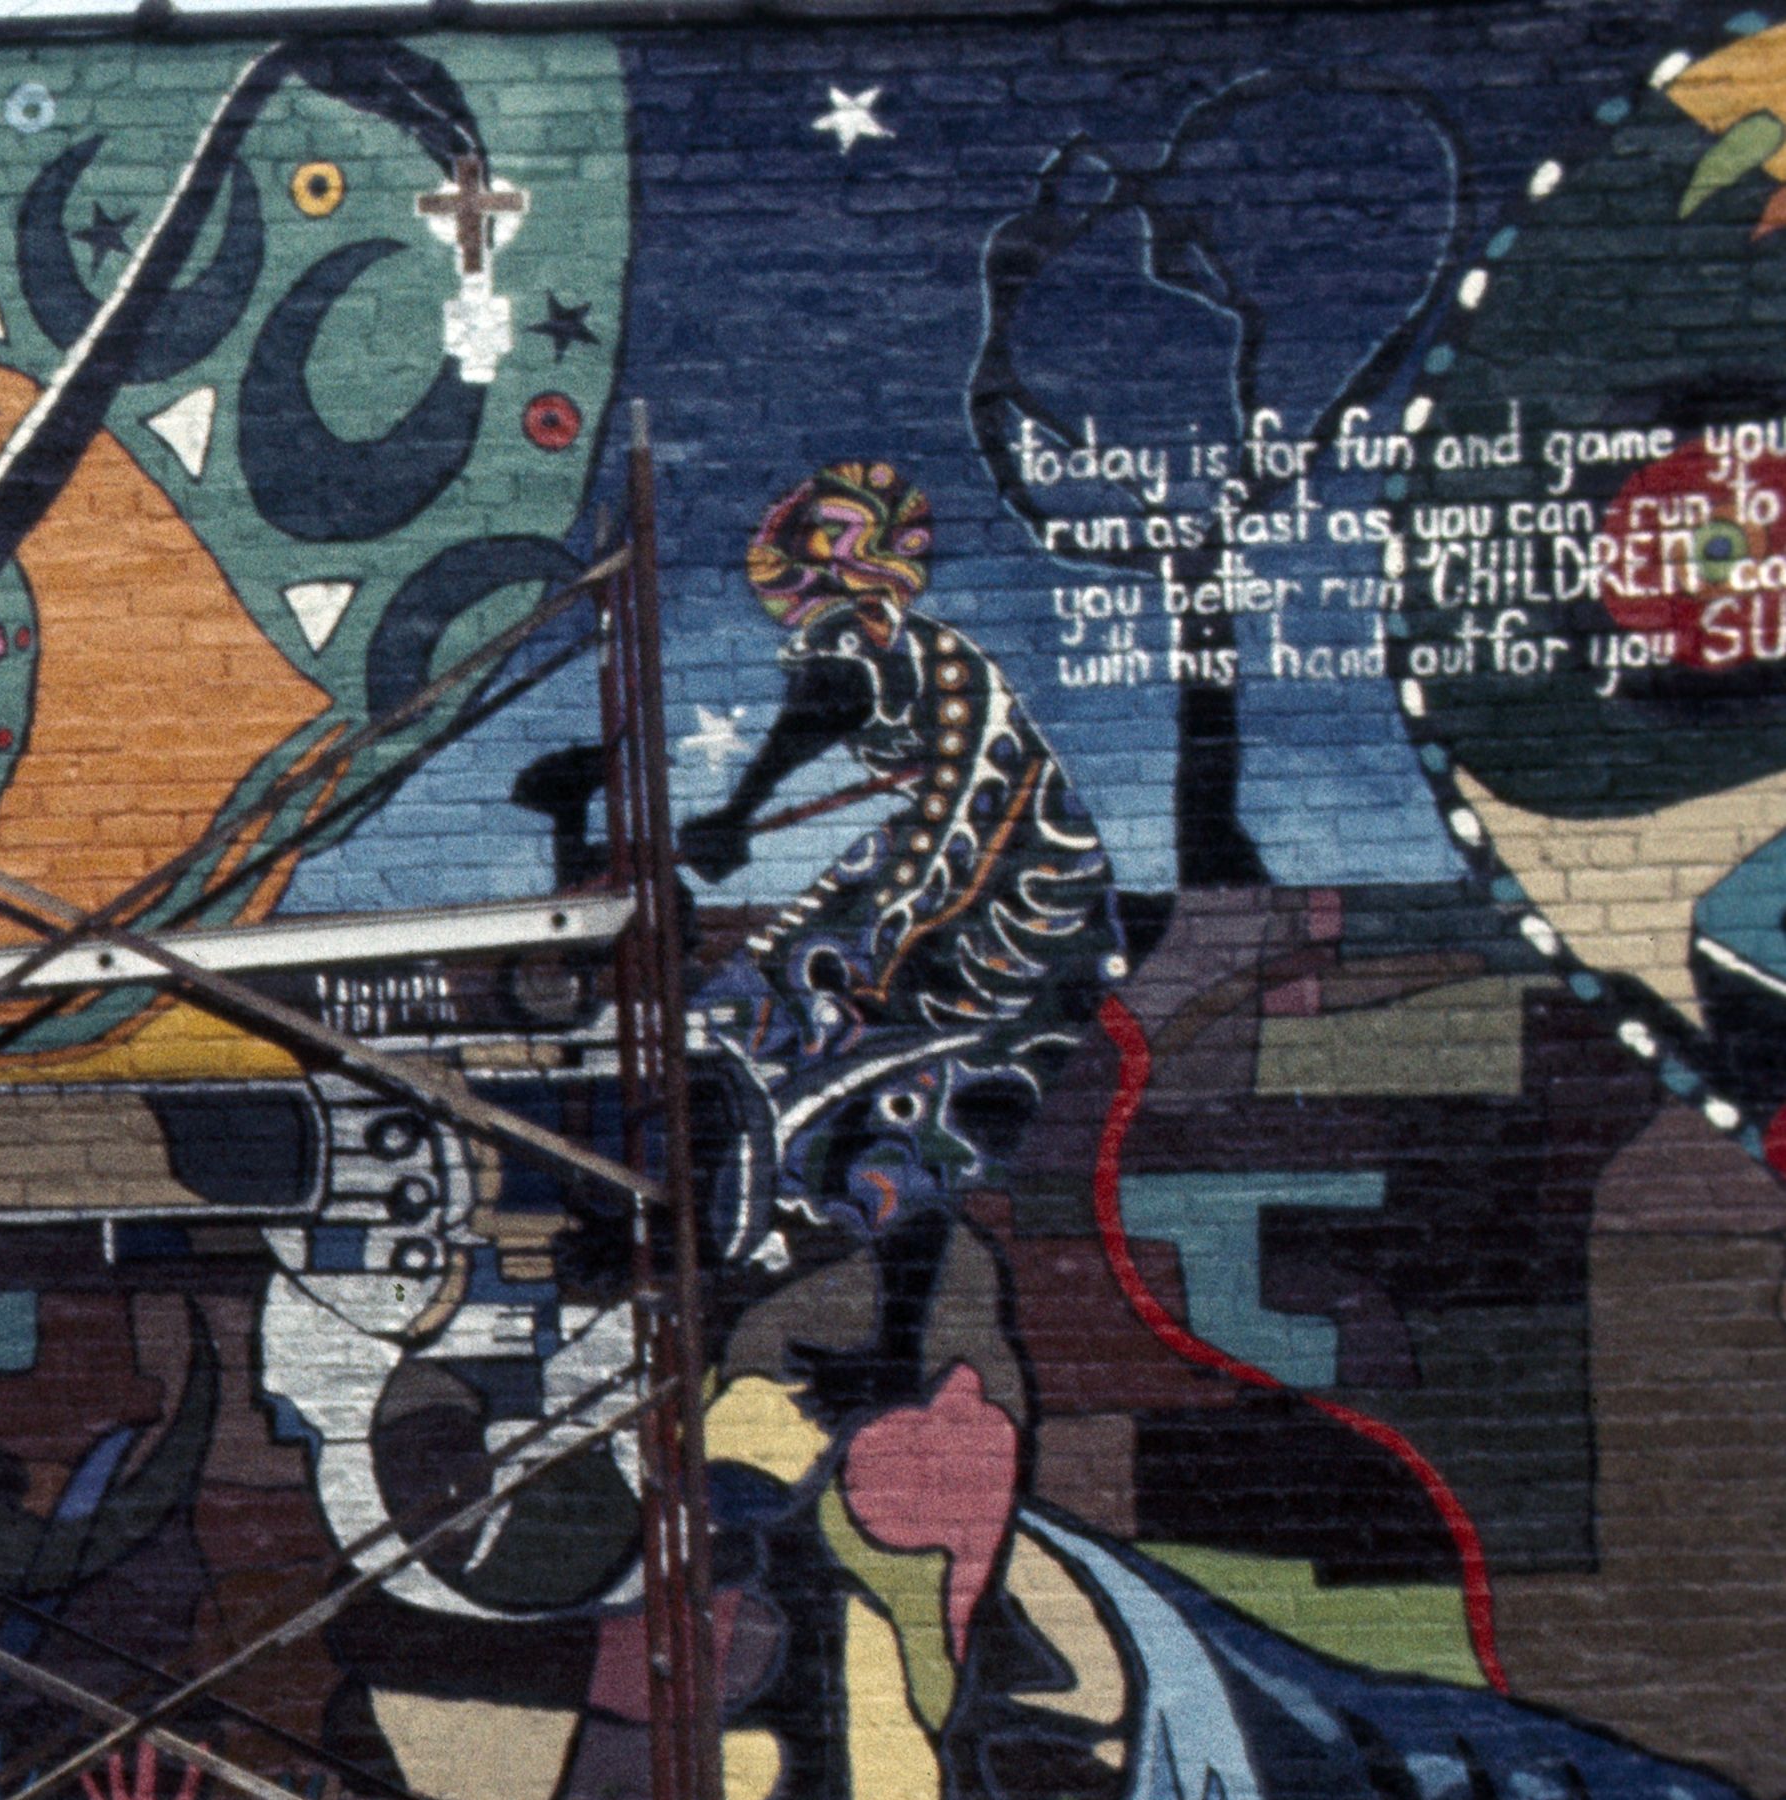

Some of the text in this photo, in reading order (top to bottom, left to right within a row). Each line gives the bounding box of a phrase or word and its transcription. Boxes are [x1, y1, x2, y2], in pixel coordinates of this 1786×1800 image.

[1010, 414, 1168, 504] today
[1189, 423, 1229, 478] is
[1244, 407, 1317, 479] for
[1333, 406, 1416, 470] fun
[1433, 399, 1524, 470] and
[1543, 428, 1676, 496] game
[1044, 515, 1131, 551] run
[1145, 513, 1205, 549] as
[1211, 478, 1322, 543] fast
[1328, 508, 1392, 543] as
[1413, 504, 1493, 567] you
[1727, 462, 1781, 526] to
[1052, 584, 1142, 646] you
[1159, 550, 1303, 613] better
[1320, 577, 1405, 612] run
[1057, 620, 1152, 688] with
[1166, 617, 1238, 688] his
[1269, 611, 1387, 680] hand
[1408, 610, 1486, 677] out
[1487, 608, 1571, 676] for
[1590, 632, 1677, 696] you
